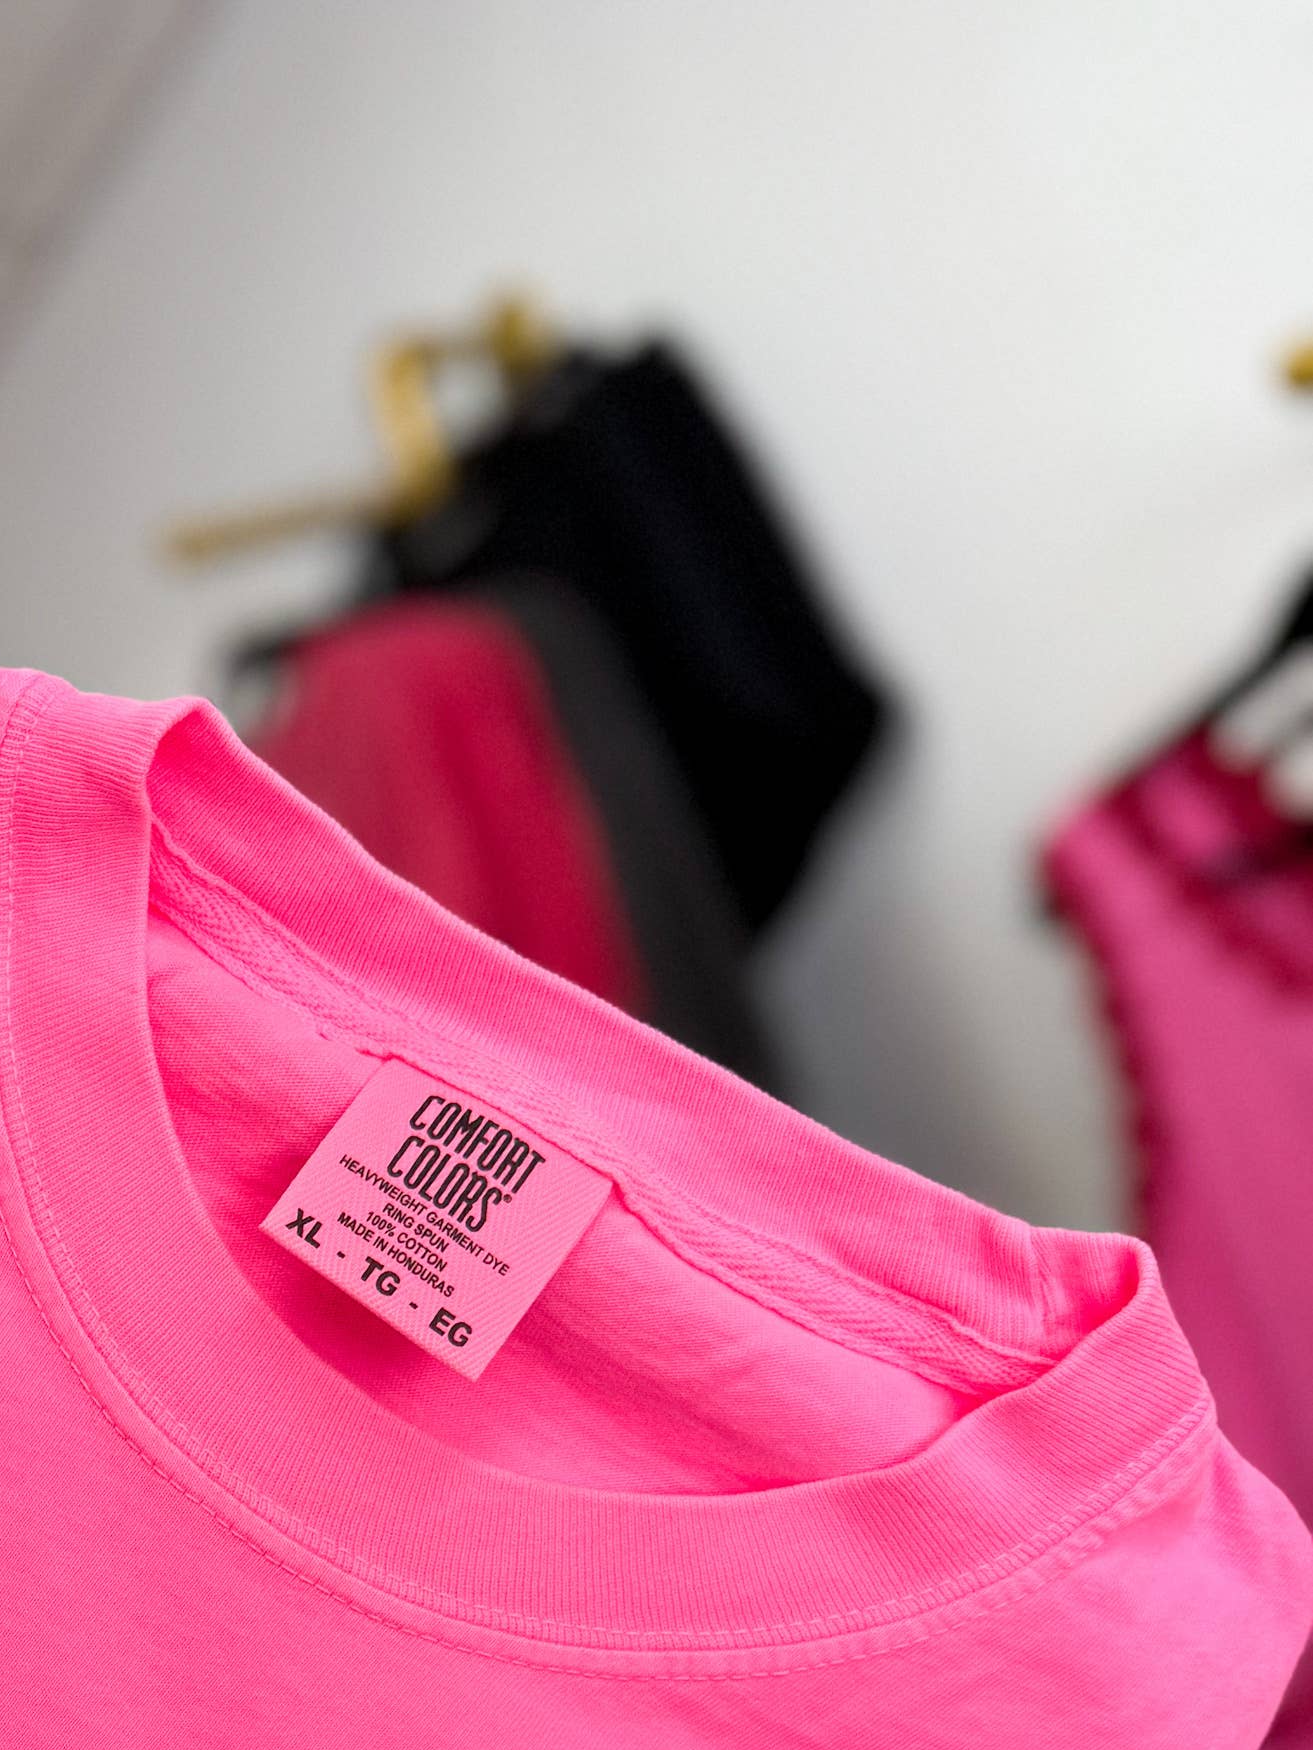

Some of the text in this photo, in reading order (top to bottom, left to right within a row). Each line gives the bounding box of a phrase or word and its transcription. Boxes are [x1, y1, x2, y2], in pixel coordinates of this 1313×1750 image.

[409, 1095, 546, 1194] COMFORT
[337, 1212, 455, 1298] MADE IN HONDURAS
[339, 1154, 510, 1276] HEAVYWEIGHT GARMENT DYE
[366, 1211, 448, 1272] 100% COTTON
[382, 1203, 450, 1253] RING SPUN
[286, 1208, 323, 1249] XL
[360, 1256, 401, 1296] TG
[429, 1307, 473, 1347] EG
